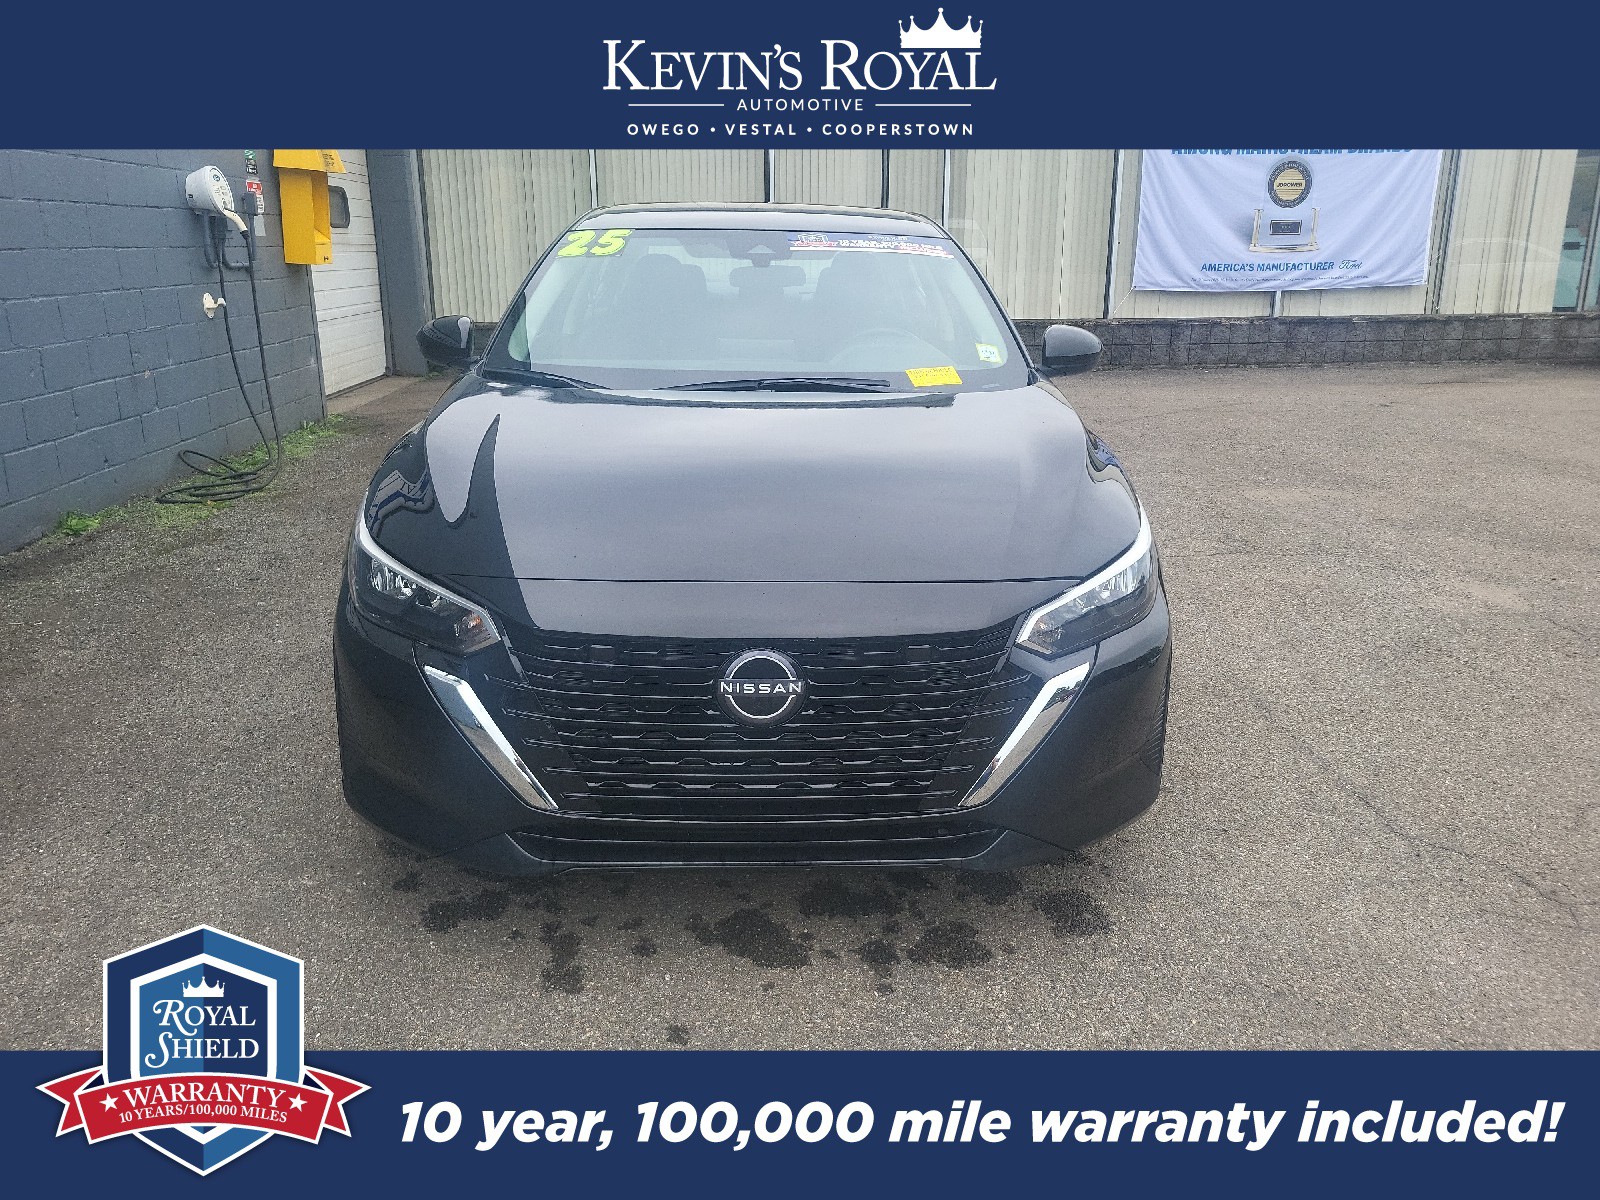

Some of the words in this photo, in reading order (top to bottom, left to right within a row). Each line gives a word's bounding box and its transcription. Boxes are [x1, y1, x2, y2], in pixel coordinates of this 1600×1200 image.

[557, 229, 632, 257] 25
[1200, 262, 1255, 272] AMERICA'S
[1256, 261, 1335, 272] MANUFACTURER
[1338, 259, 1363, 270] Ford
[720, 681, 802, 694] NISSAN
